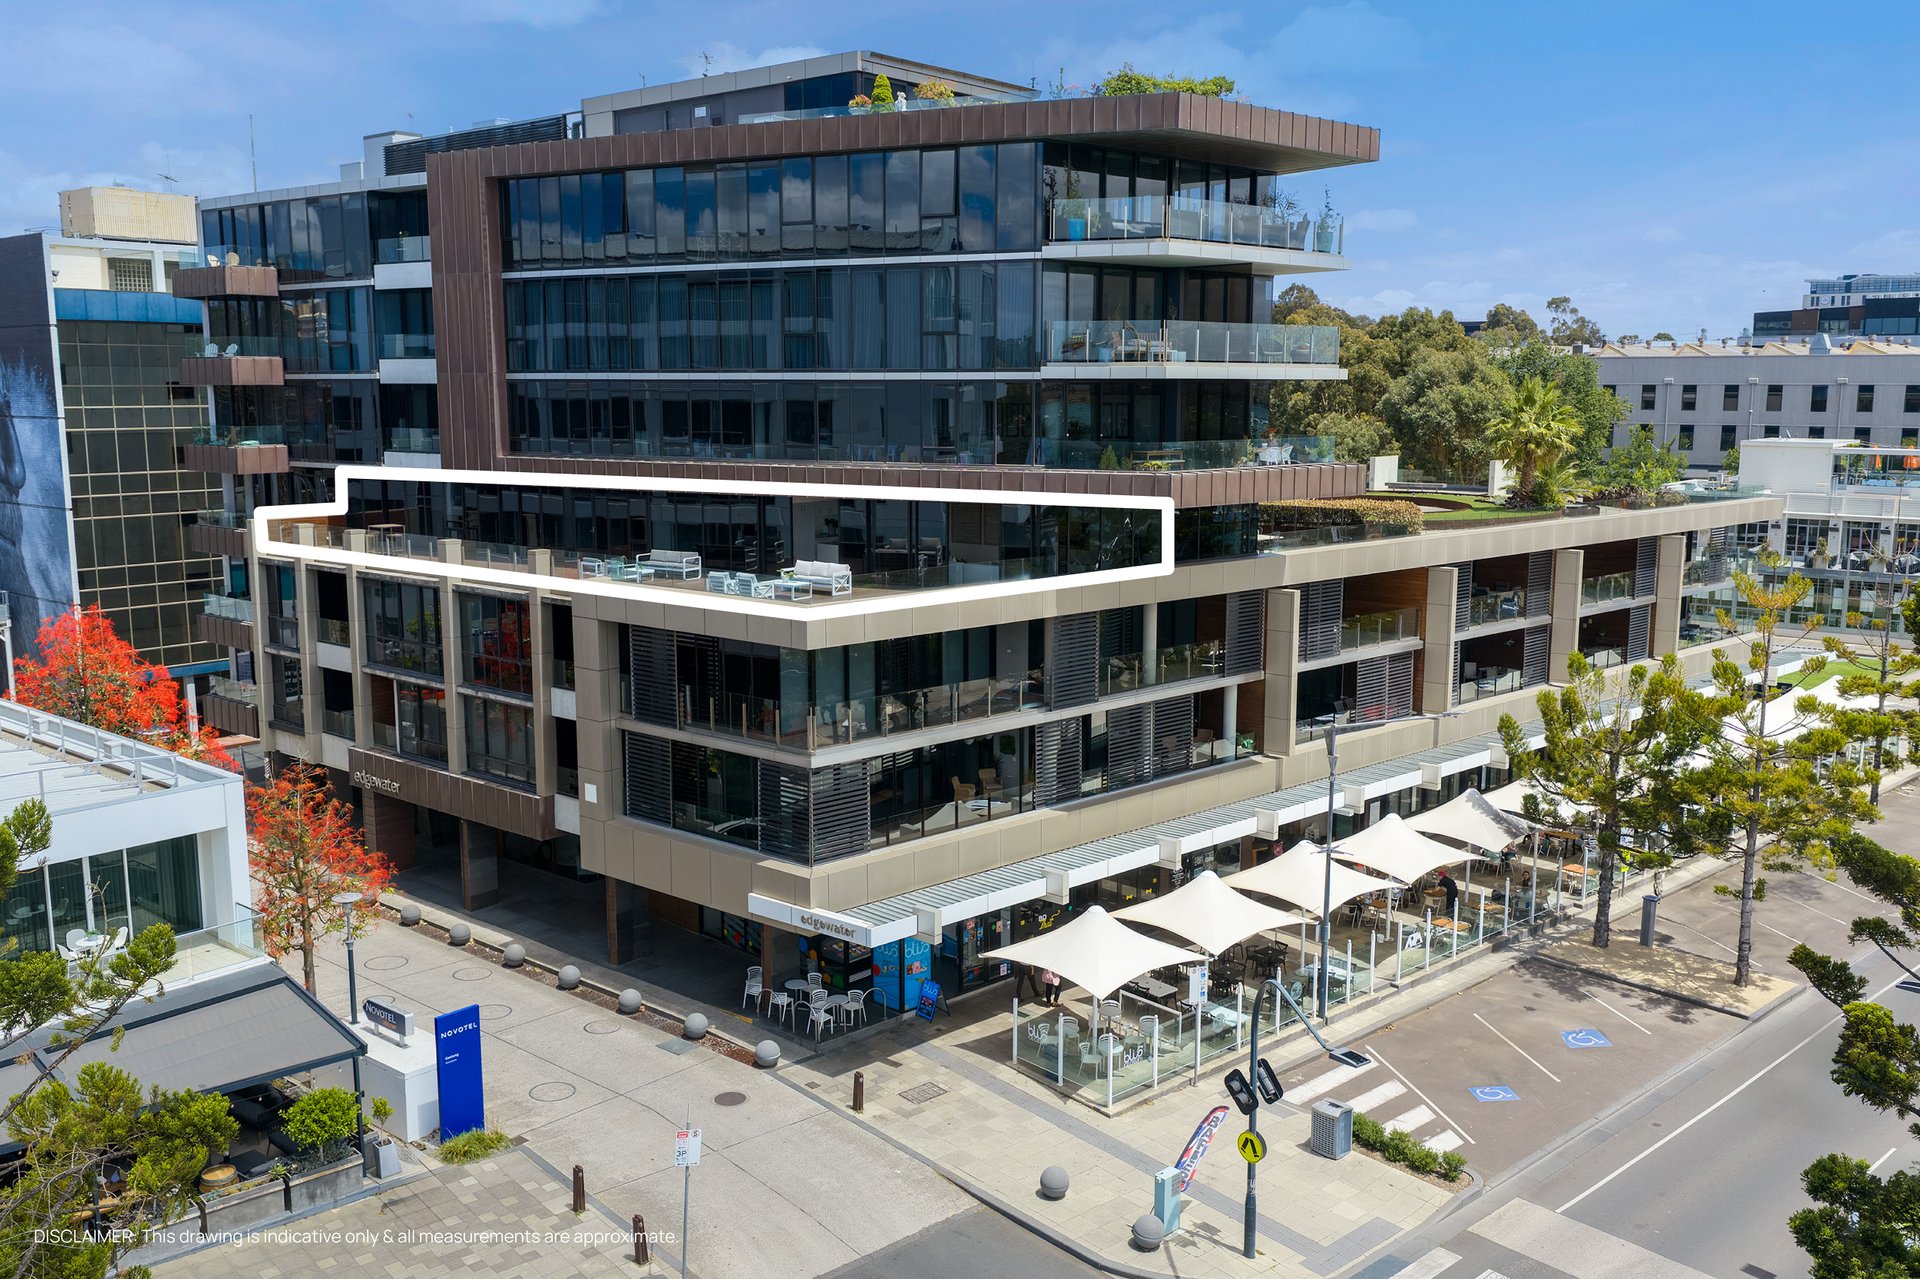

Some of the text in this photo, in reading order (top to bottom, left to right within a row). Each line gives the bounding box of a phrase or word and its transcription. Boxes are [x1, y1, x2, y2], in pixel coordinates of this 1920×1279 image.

[354, 769, 401, 794] edgewater
[800, 913, 857, 938] edgewater
[365, 1002, 397, 1024] NOVOTEL
[440, 1021, 478, 1039] NOVOTEL
